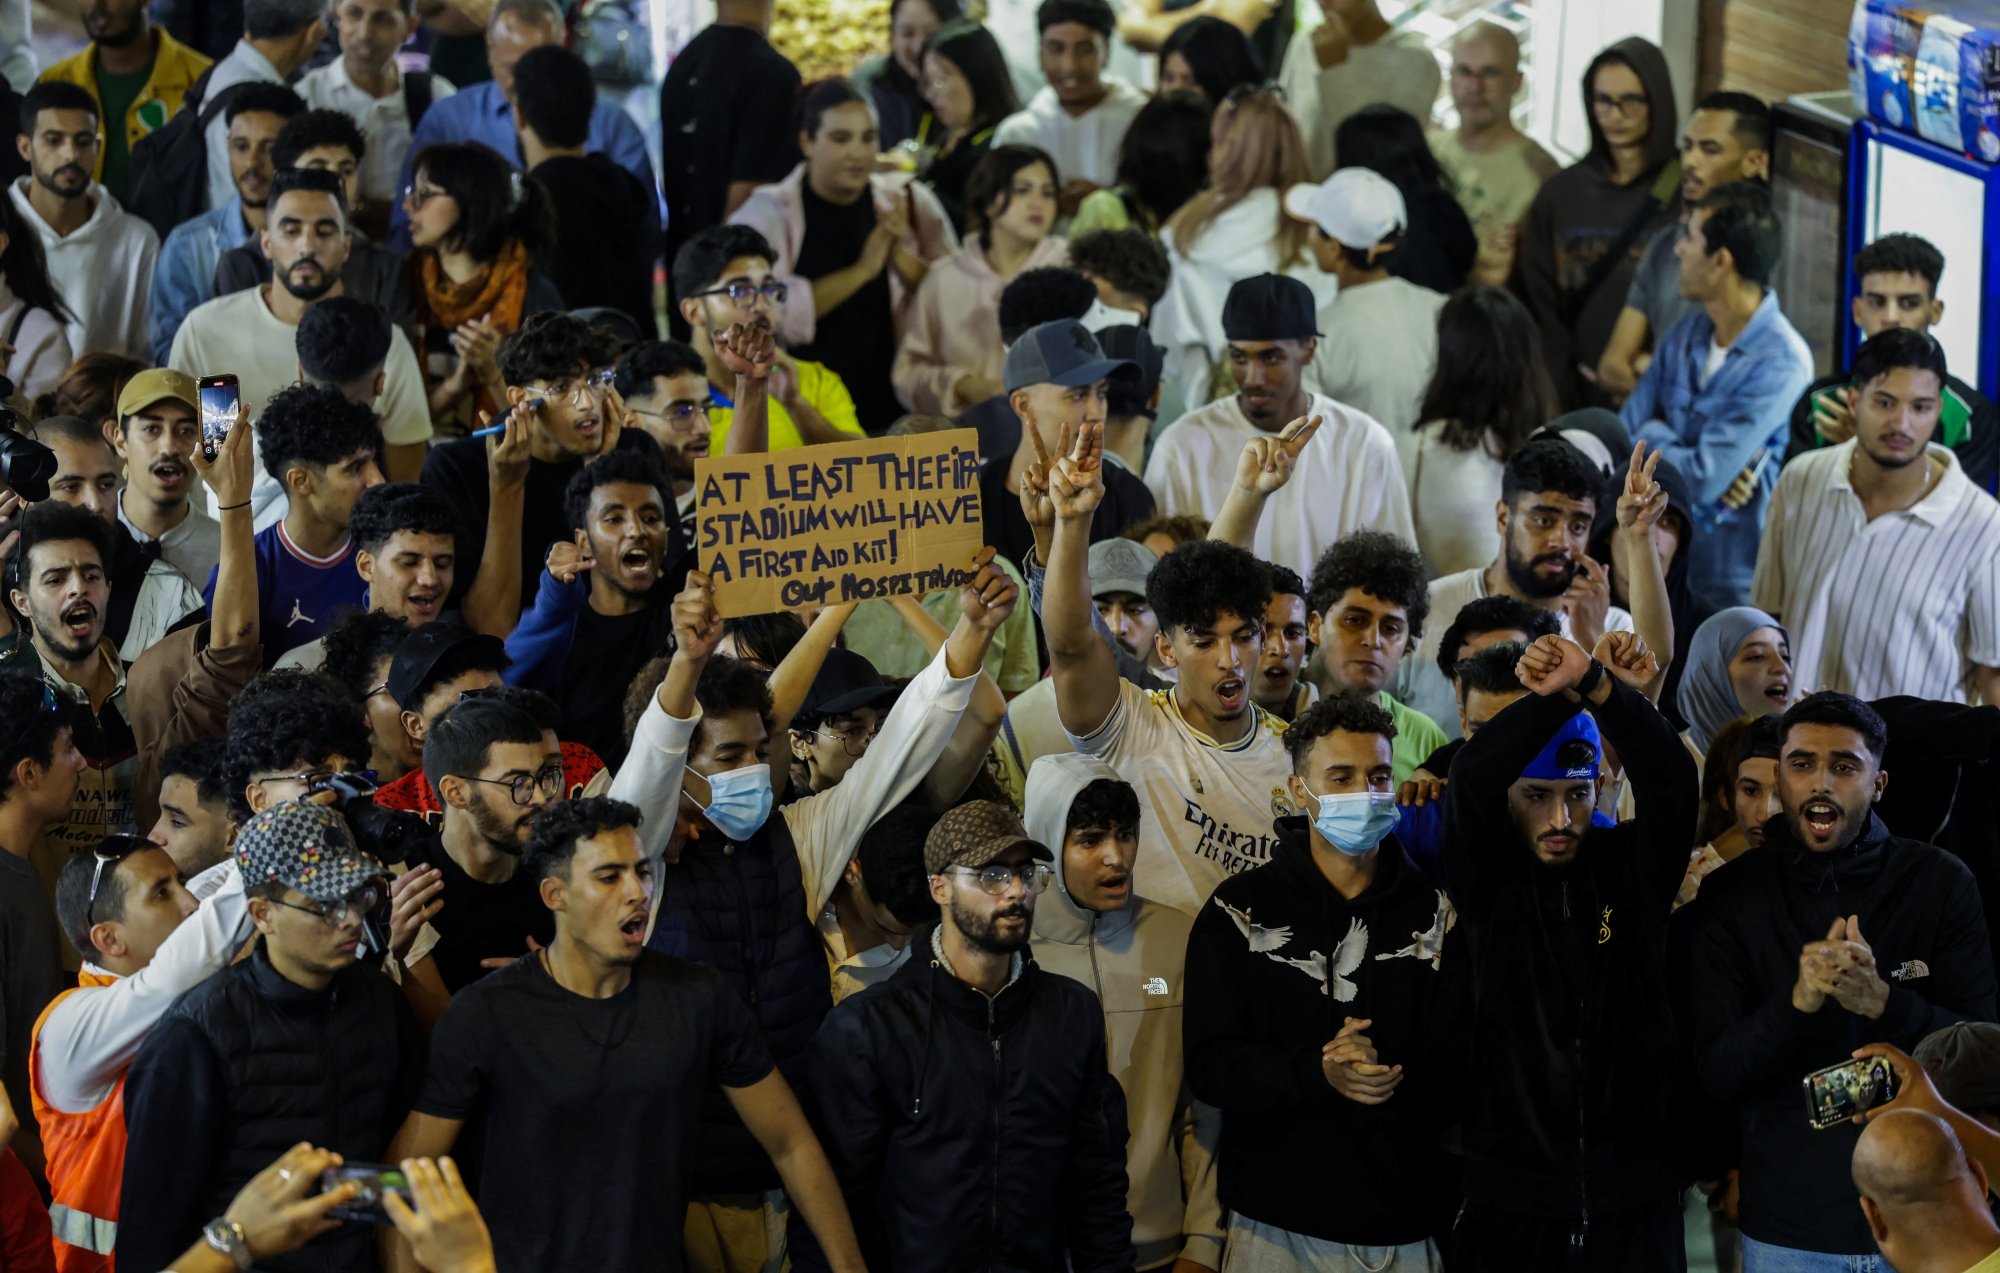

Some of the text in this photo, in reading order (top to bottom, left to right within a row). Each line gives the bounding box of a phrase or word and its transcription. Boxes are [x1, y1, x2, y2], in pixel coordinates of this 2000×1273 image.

[700, 472, 750, 507] AT
[764, 456, 863, 502] LEAST
[867, 453, 933, 491] THE
[831, 498, 896, 529] WILL
[899, 494, 980, 530] HAVE
[709, 551, 732, 583] A
[811, 542, 849, 572] AID
[1891, 968, 1917, 978] NORTH
[1899, 973, 1918, 981] FACE
[1900, 961, 1916, 970] THE
